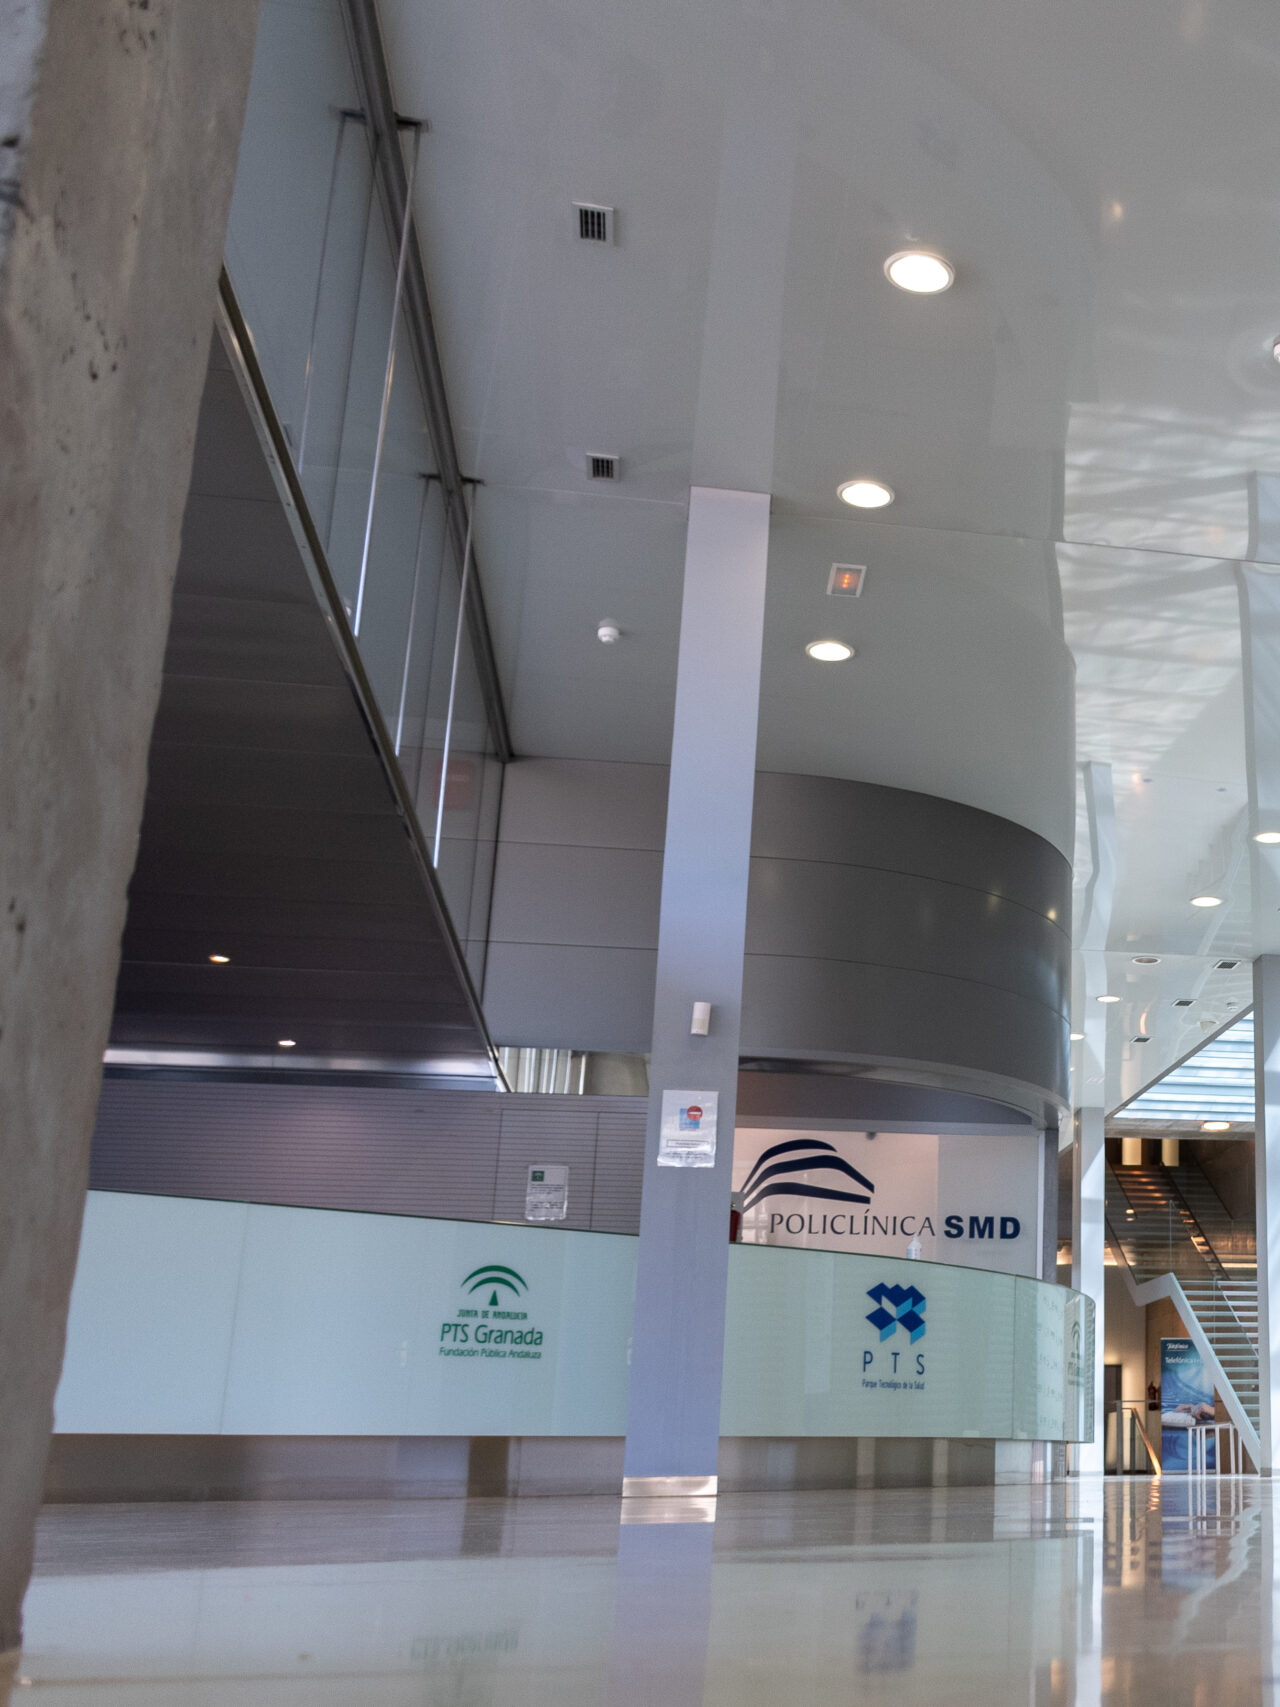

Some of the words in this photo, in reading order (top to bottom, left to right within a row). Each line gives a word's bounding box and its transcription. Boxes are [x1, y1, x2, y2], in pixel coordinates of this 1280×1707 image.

[770, 1209, 935, 1237] POLICLÍNICA
[944, 1215, 1021, 1240] SMD
[457, 1309, 478, 1318] JUNTA
[481, 1310, 490, 1319] DE
[440, 1323, 469, 1343] PTS
[474, 1324, 544, 1345] Granada
[439, 1347, 479, 1358] Fundación
[480, 1348, 507, 1358] Pública
[508, 1349, 542, 1359] Andaluza
[863, 1350, 925, 1375] PTS
